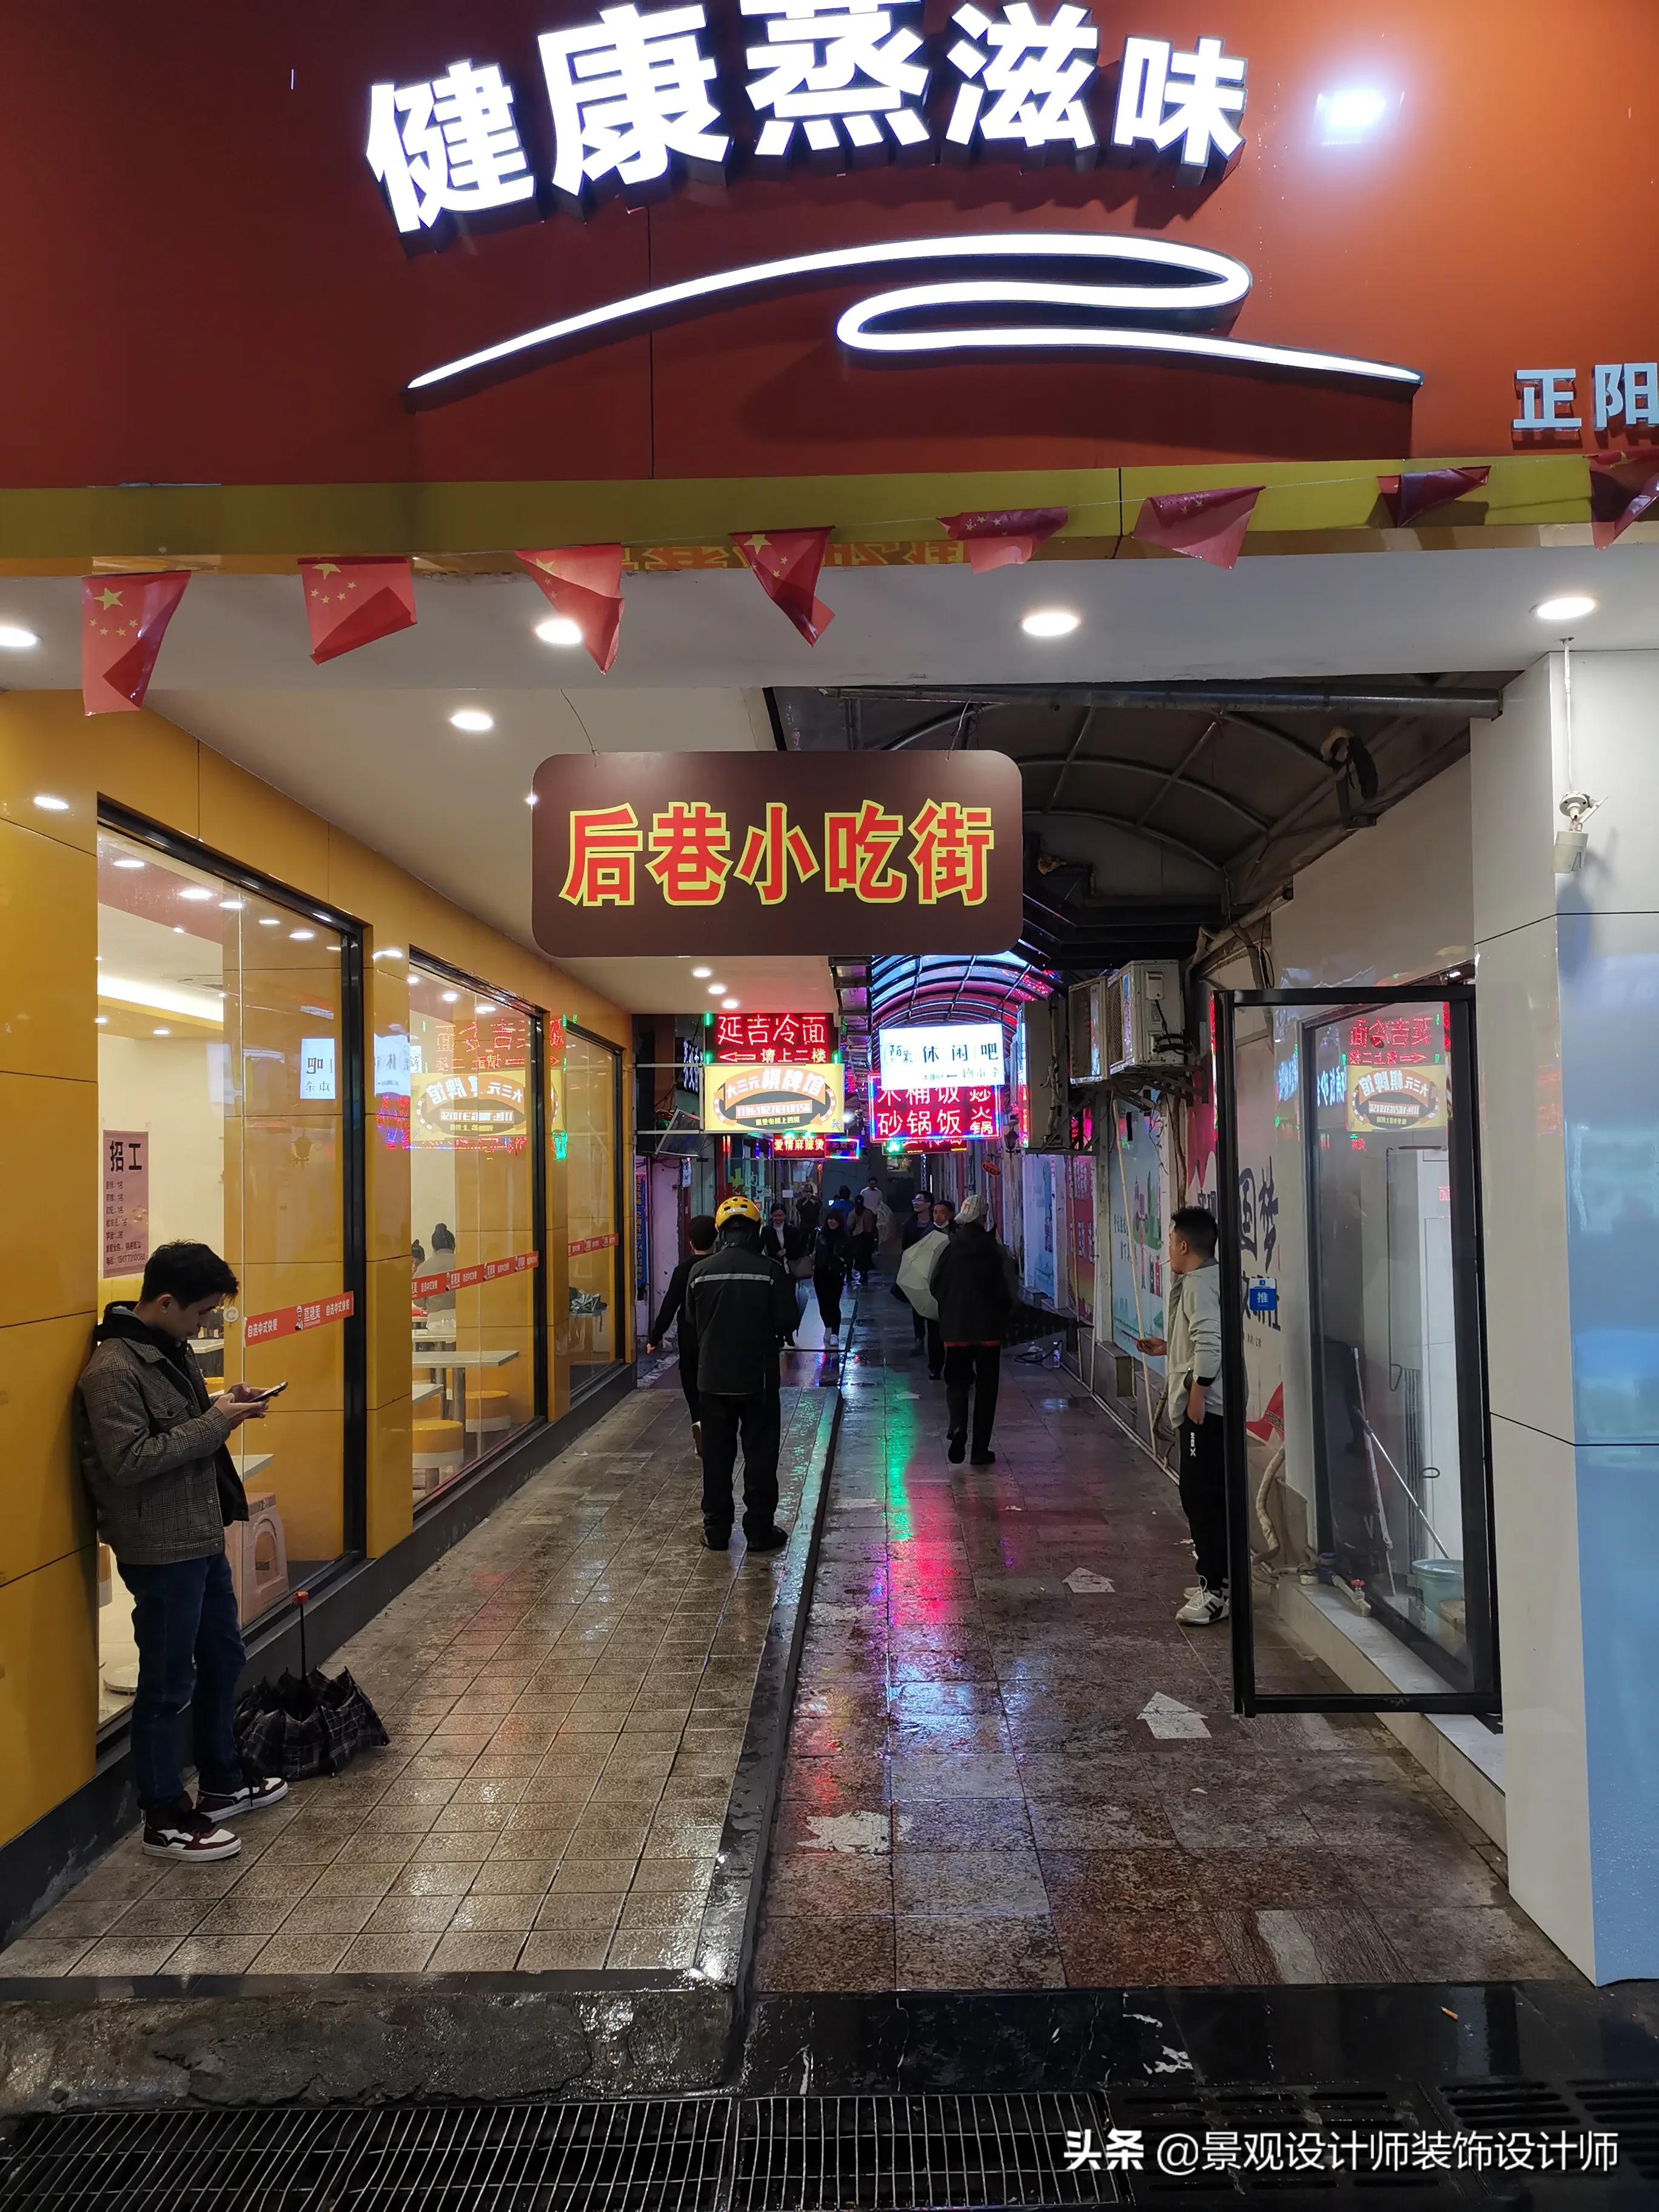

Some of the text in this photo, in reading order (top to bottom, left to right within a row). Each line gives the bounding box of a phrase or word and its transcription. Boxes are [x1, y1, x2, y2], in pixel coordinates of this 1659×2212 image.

[365, 0, 1246, 232] 健康蒸滋味
[1512, 363, 1659, 428] 正阳
[558, 799, 994, 907] 后巷小吃街
[718, 1014, 826, 1045] 延吉冷面
[922, 1042, 999, 1063] 休闲吧
[726, 1067, 826, 1099] 大三元棋牌馆
[877, 1108, 962, 1138] 砂锅饭
[110, 1141, 142, 1173] 招工
[774, 1138, 825, 1151] 爱情麻辣烫
[1257, 1291, 1270, 1304] 推
